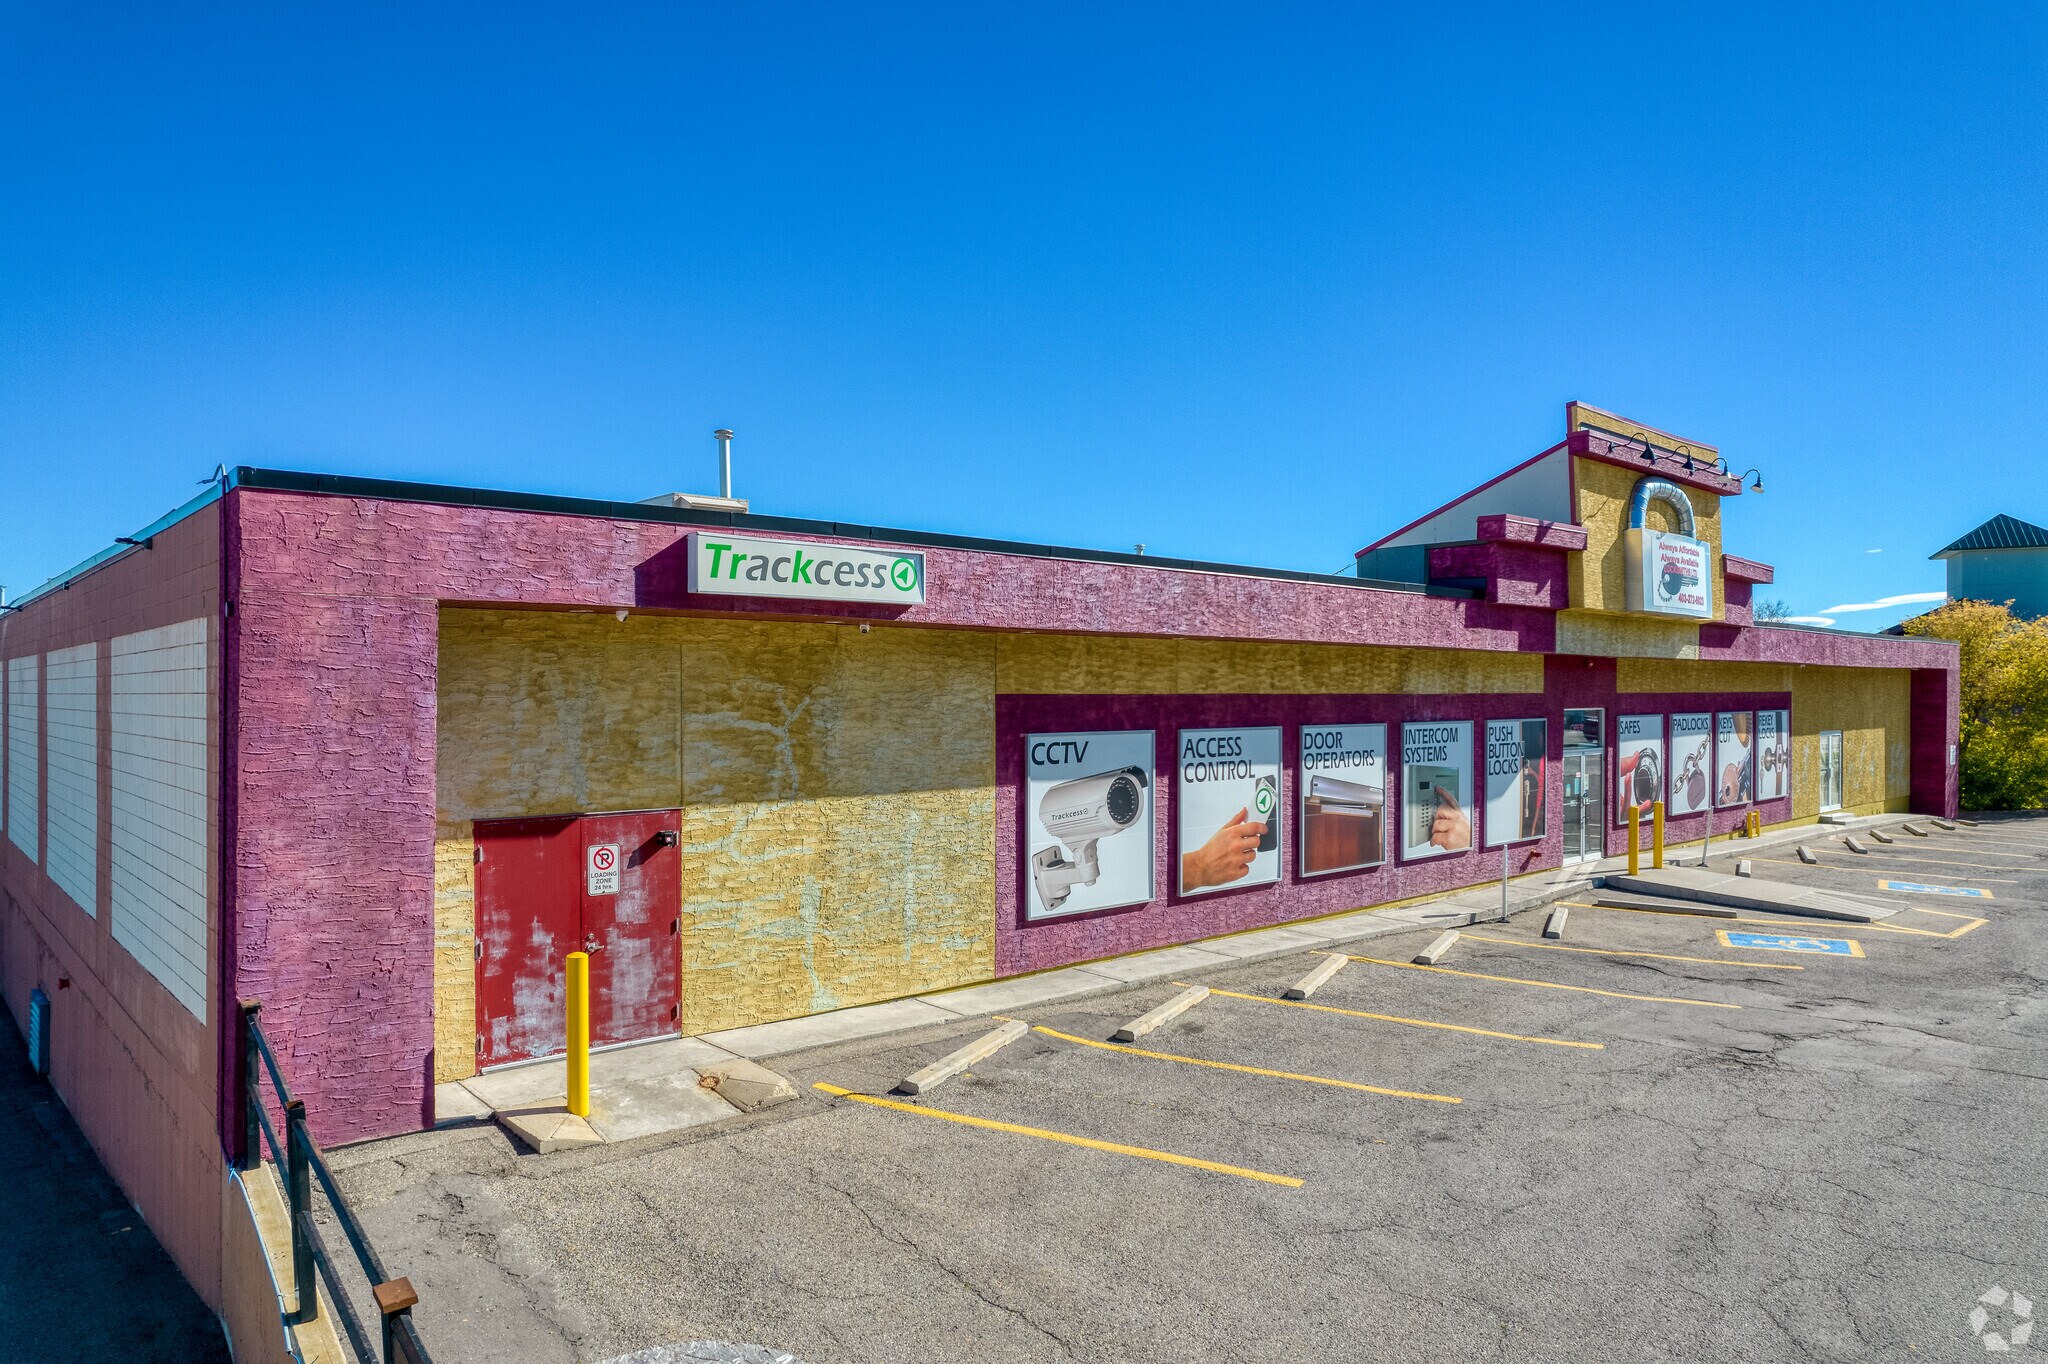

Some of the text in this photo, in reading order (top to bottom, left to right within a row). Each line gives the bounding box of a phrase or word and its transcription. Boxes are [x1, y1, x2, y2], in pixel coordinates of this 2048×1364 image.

[1659, 542, 1699, 557] Always Affordable
[705, 543, 887, 589] Trackcess
[1661, 553, 1680, 564] Always
[1620, 720, 1641, 735] SAFES
[1673, 717, 1709, 732] PADLOCKS
[1719, 717, 1733, 729] KEYS
[1304, 732, 1343, 750] DOOR
[1405, 727, 1458, 745] INTERCOM
[1489, 726, 1513, 742] PUSH
[1719, 731, 1731, 743] CUT
[1759, 727, 1775, 739] LOCKS
[1031, 741, 1089, 766] CCTV
[1183, 736, 1243, 759] ACCESS
[1405, 746, 1448, 764] SYSTEMS
[1489, 742, 1524, 759] BUTTON
[1304, 750, 1375, 770] OPERATORS
[1489, 759, 1519, 776] LOCKS
[1184, 760, 1255, 783] CONTROL
[1051, 809, 1083, 821] Trackcess
